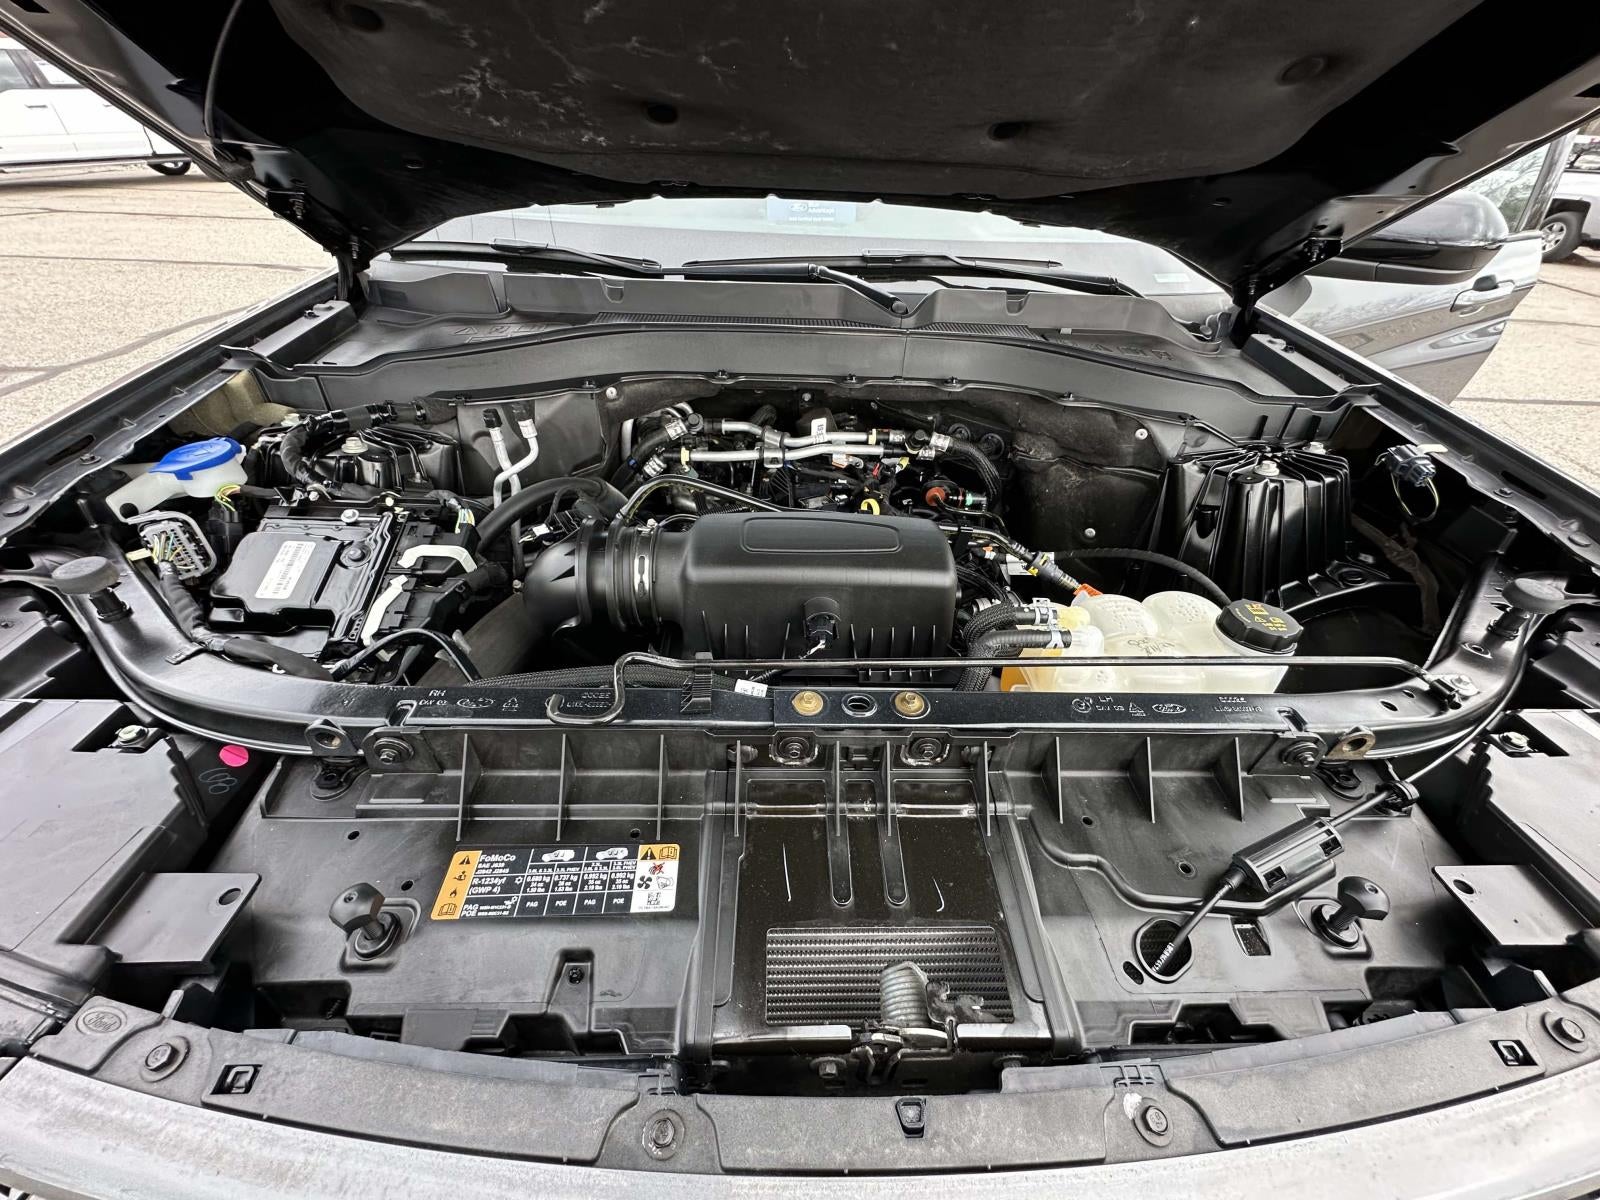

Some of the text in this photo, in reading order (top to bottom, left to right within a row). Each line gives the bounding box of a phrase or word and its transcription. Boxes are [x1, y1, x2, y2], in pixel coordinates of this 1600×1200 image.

[472, 877, 507, 885] R-1234yf
[469, 886, 501, 895] (GWP 4)
[85, 1012, 120, 1032] Ford
